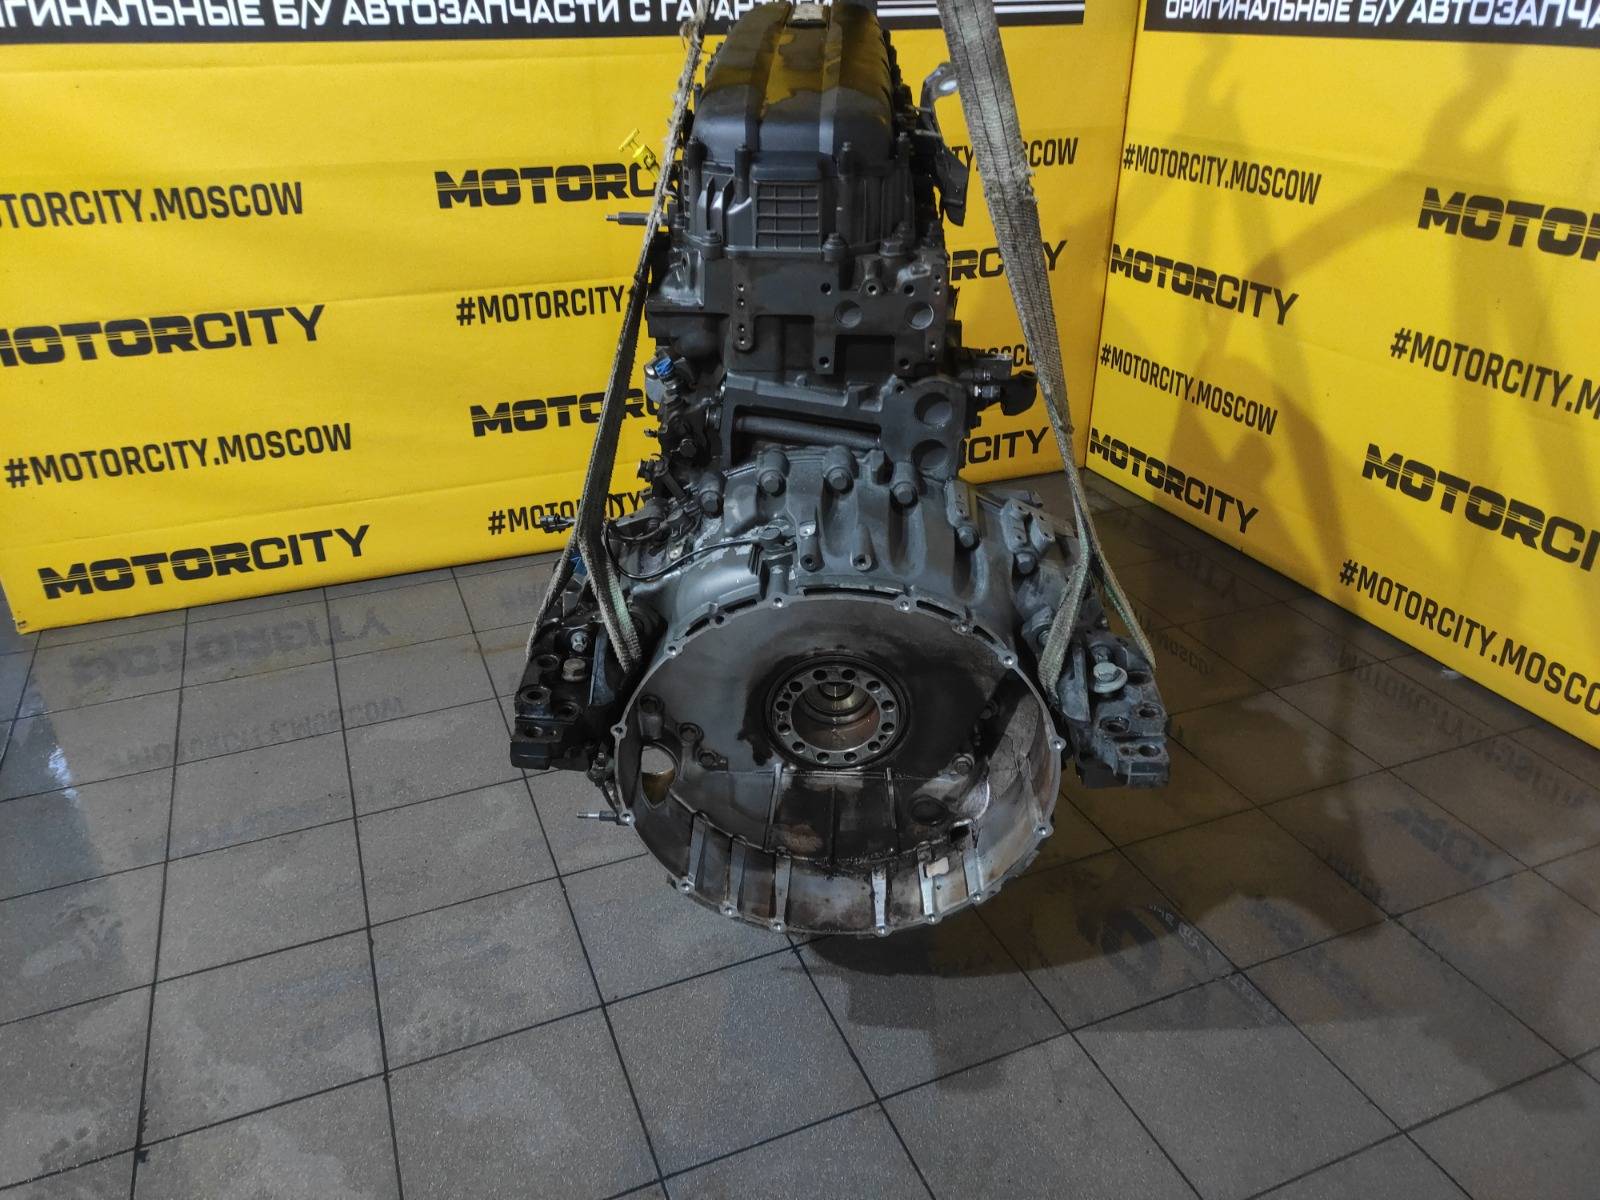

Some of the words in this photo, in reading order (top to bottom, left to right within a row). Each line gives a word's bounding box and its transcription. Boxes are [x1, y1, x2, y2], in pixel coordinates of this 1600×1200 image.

[0, 0, 265, 27] ГИНАЛЬНЫЕ
[274, 0, 332, 29] Б/У
[342, 0, 620, 26] АВТОЗАПЧАСТИ
[1165, 0, 1351, 22] ОРИГИНАЛЬНЫЕ
[1358, 0, 1402, 27] Б/У
[0, 182, 303, 228] TORCITY.MOSCOW
[1123, 144, 1322, 206] #MOTORCITY.MOSCOW
[456, 285, 625, 326] #MOTORCITY
[1110, 243, 1299, 326] MOTORCITY
[1100, 343, 1278, 435] #MOTORCITY.MOSCOW
[4, 422, 352, 488] #MOTORCITY.MOSCOW
[1089, 428, 1259, 534] MOTORCITY
[37, 524, 370, 600] MOTORCITY
